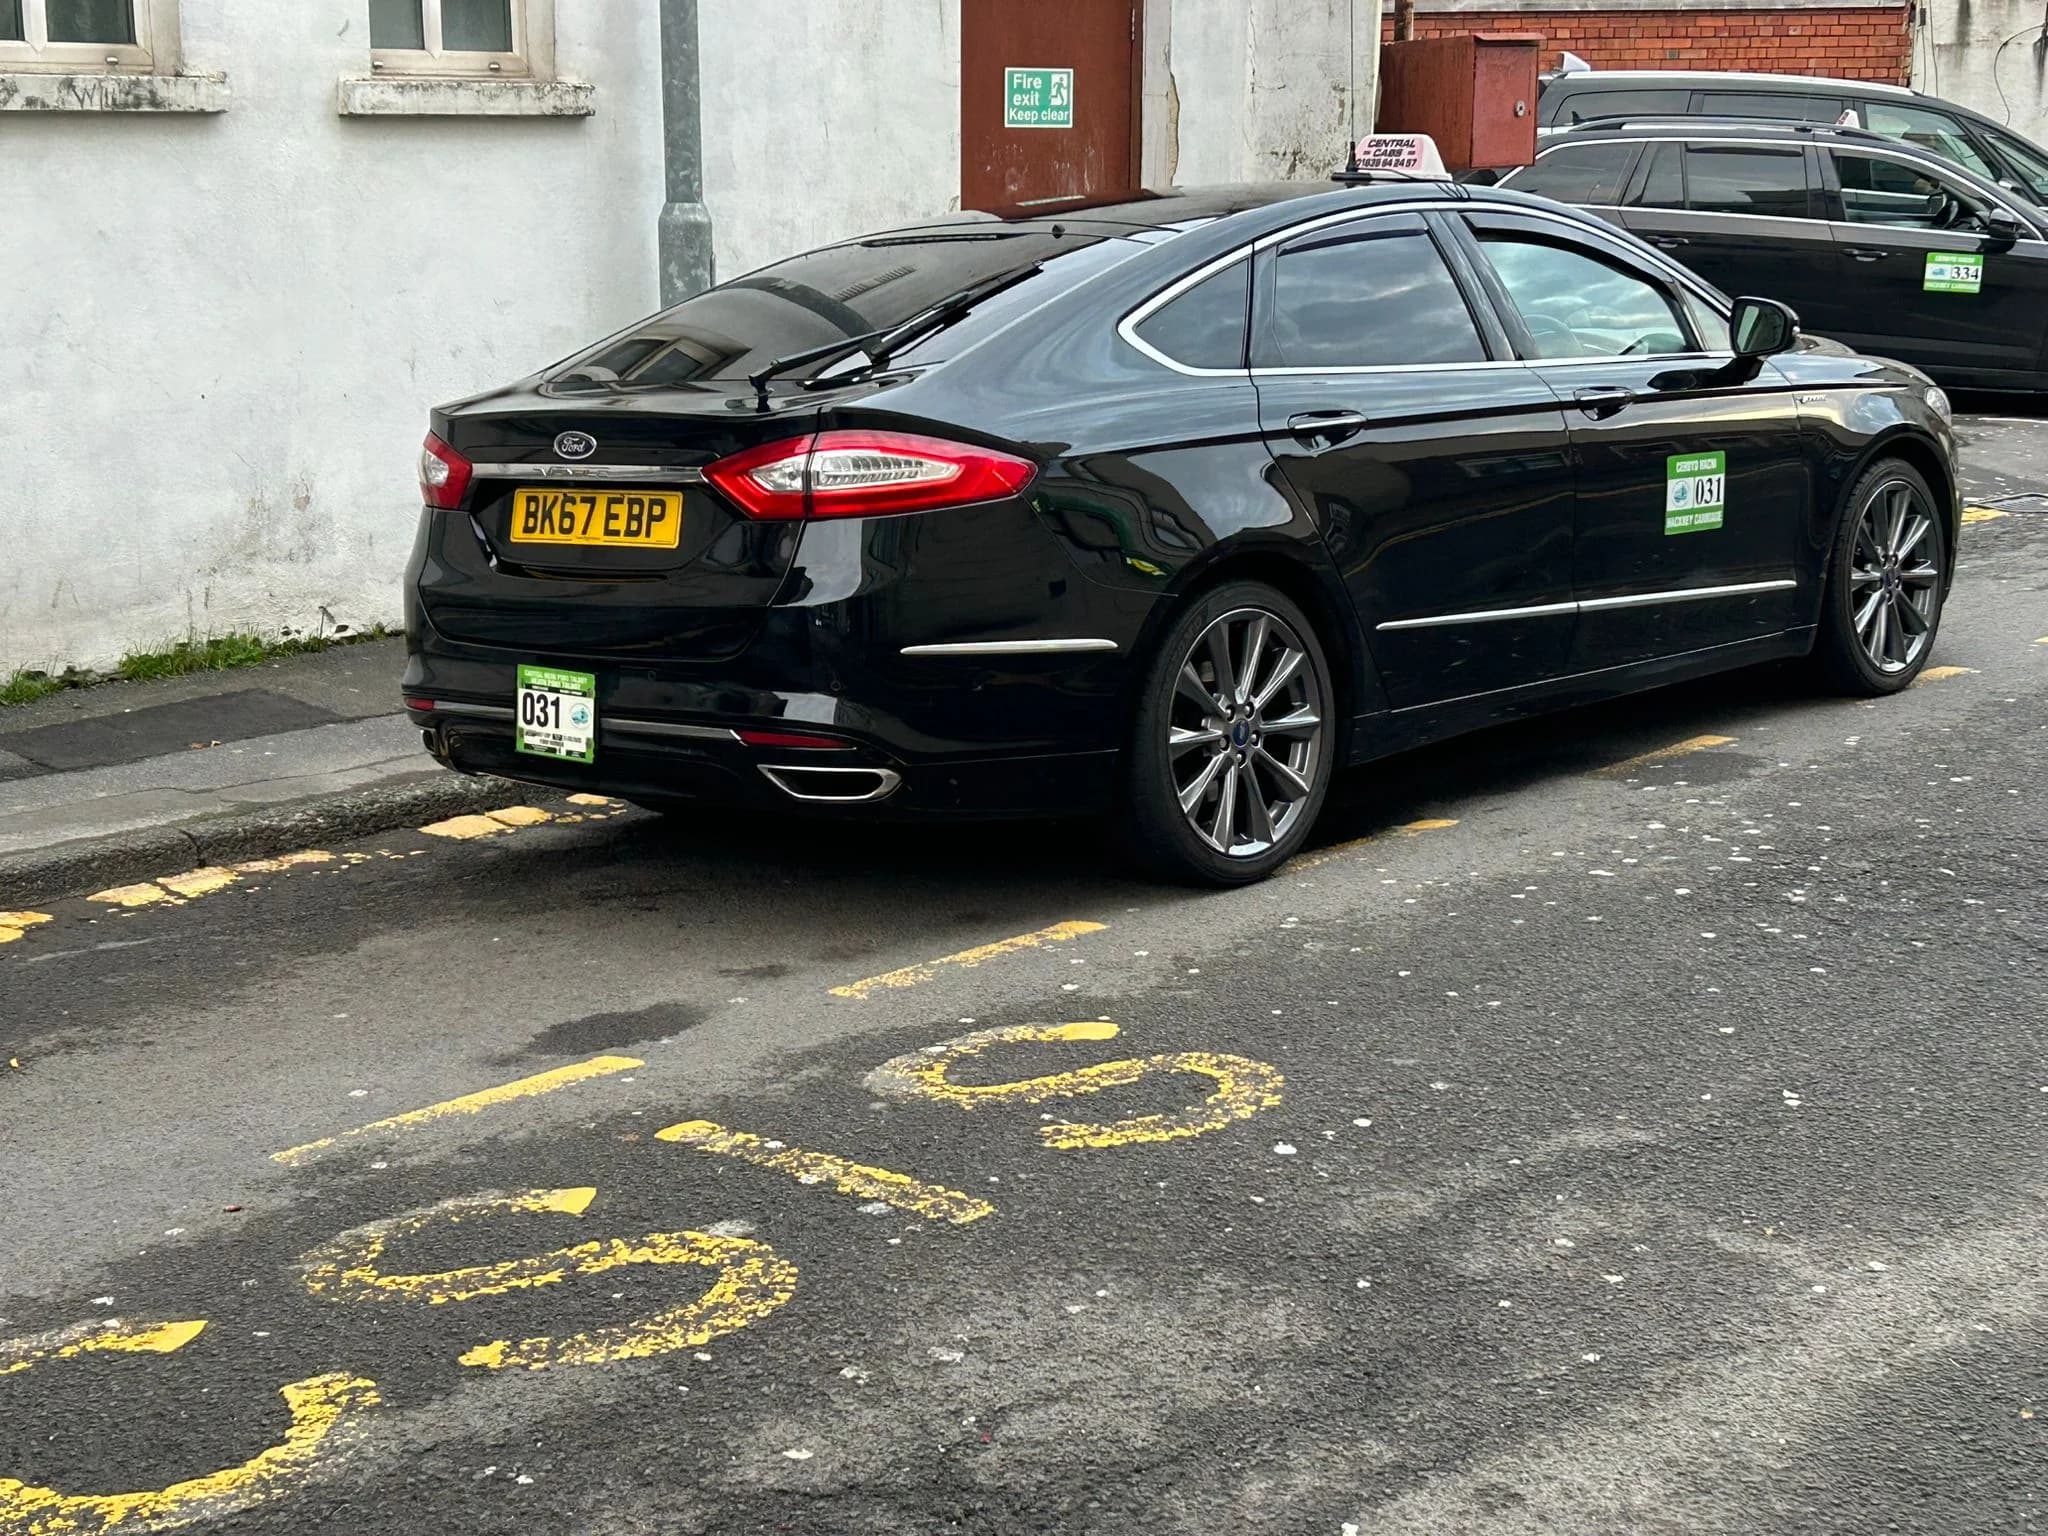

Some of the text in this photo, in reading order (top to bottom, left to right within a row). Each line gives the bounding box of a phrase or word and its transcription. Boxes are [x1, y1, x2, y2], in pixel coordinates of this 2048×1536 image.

[1013, 73, 1042, 89] Fire
[1013, 90, 1039, 106] exit
[1009, 107, 1069, 123] Keep clear
[1367, 138, 1416, 148] CENTRAL
[1372, 149, 1403, 158] CABS
[1951, 266, 1980, 281] 334
[561, 436, 586, 453] Ford
[1695, 477, 1722, 505] 031
[522, 495, 667, 540] BK67 EBP
[522, 691, 560, 729] 031
